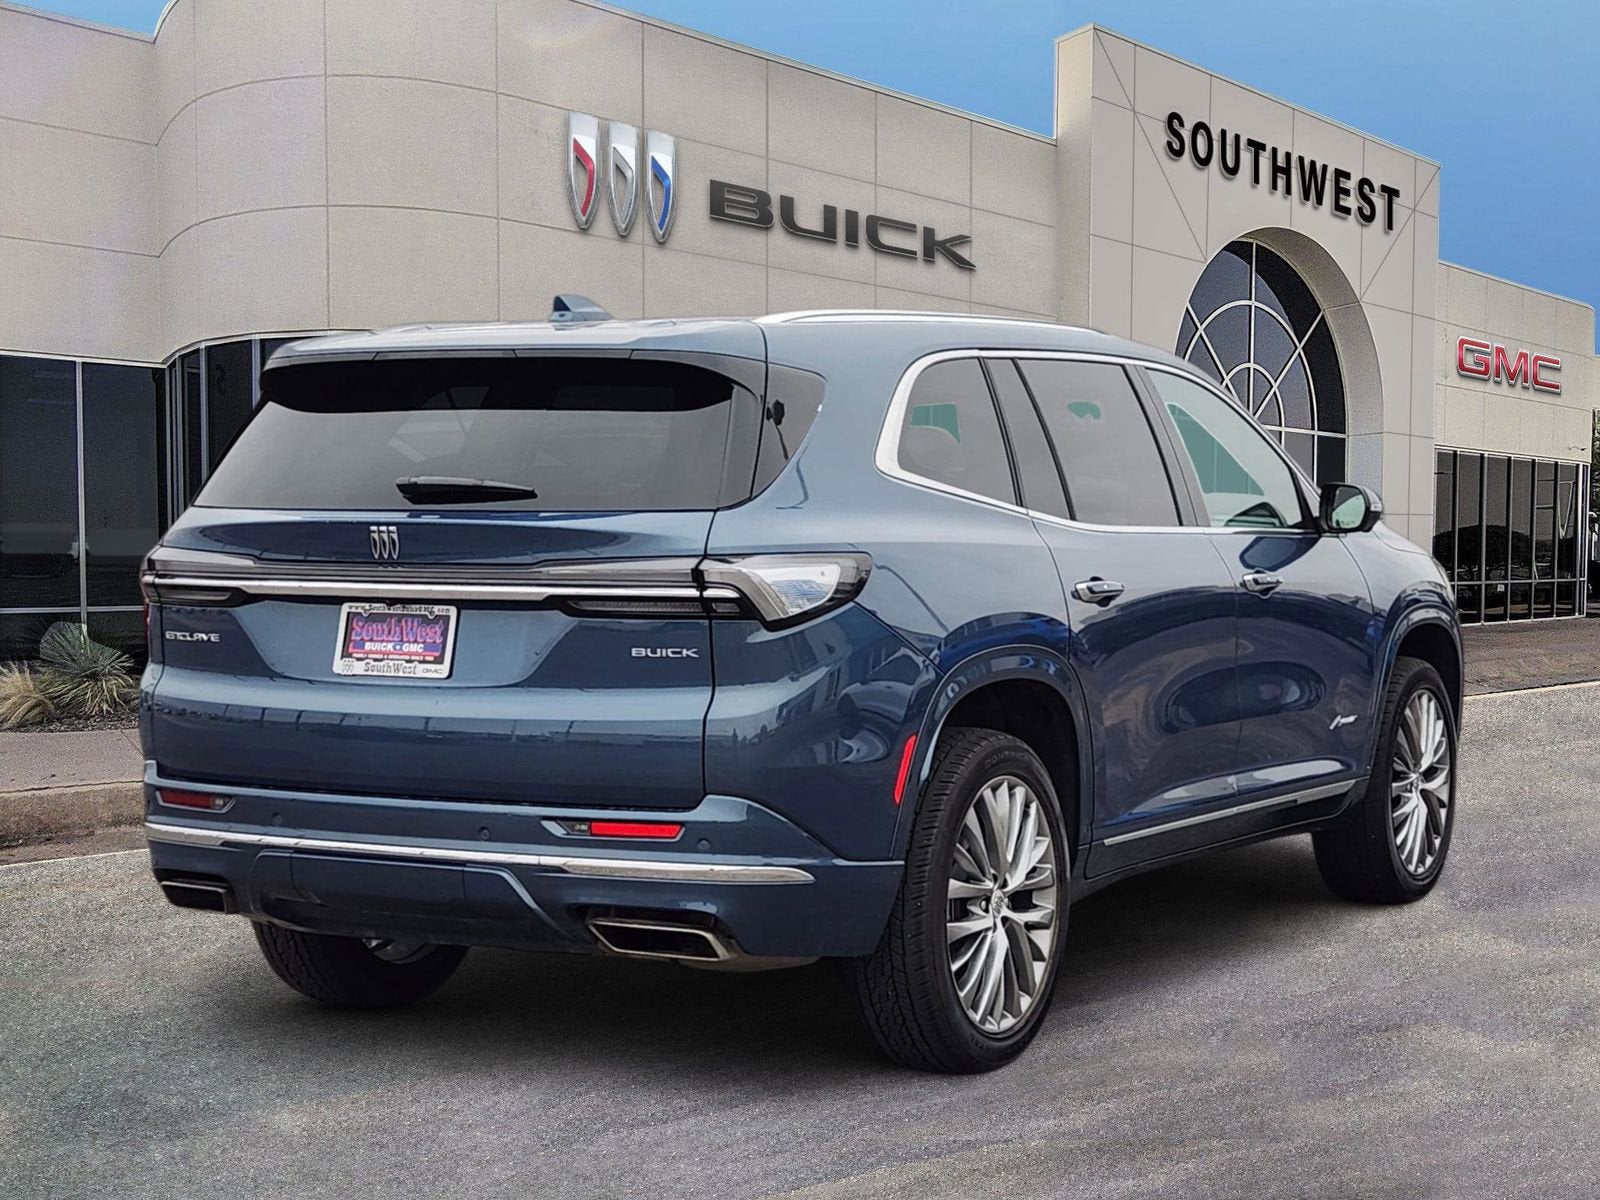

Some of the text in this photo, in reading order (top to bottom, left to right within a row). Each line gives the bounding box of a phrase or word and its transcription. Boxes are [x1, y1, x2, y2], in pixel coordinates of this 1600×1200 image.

[1165, 110, 1401, 232] SOUTHWEST
[709, 178, 977, 271] BUICK
[1456, 335, 1562, 393] GMC
[364, 642, 425, 652] BUICK GMC
[630, 647, 700, 658] BUICK
